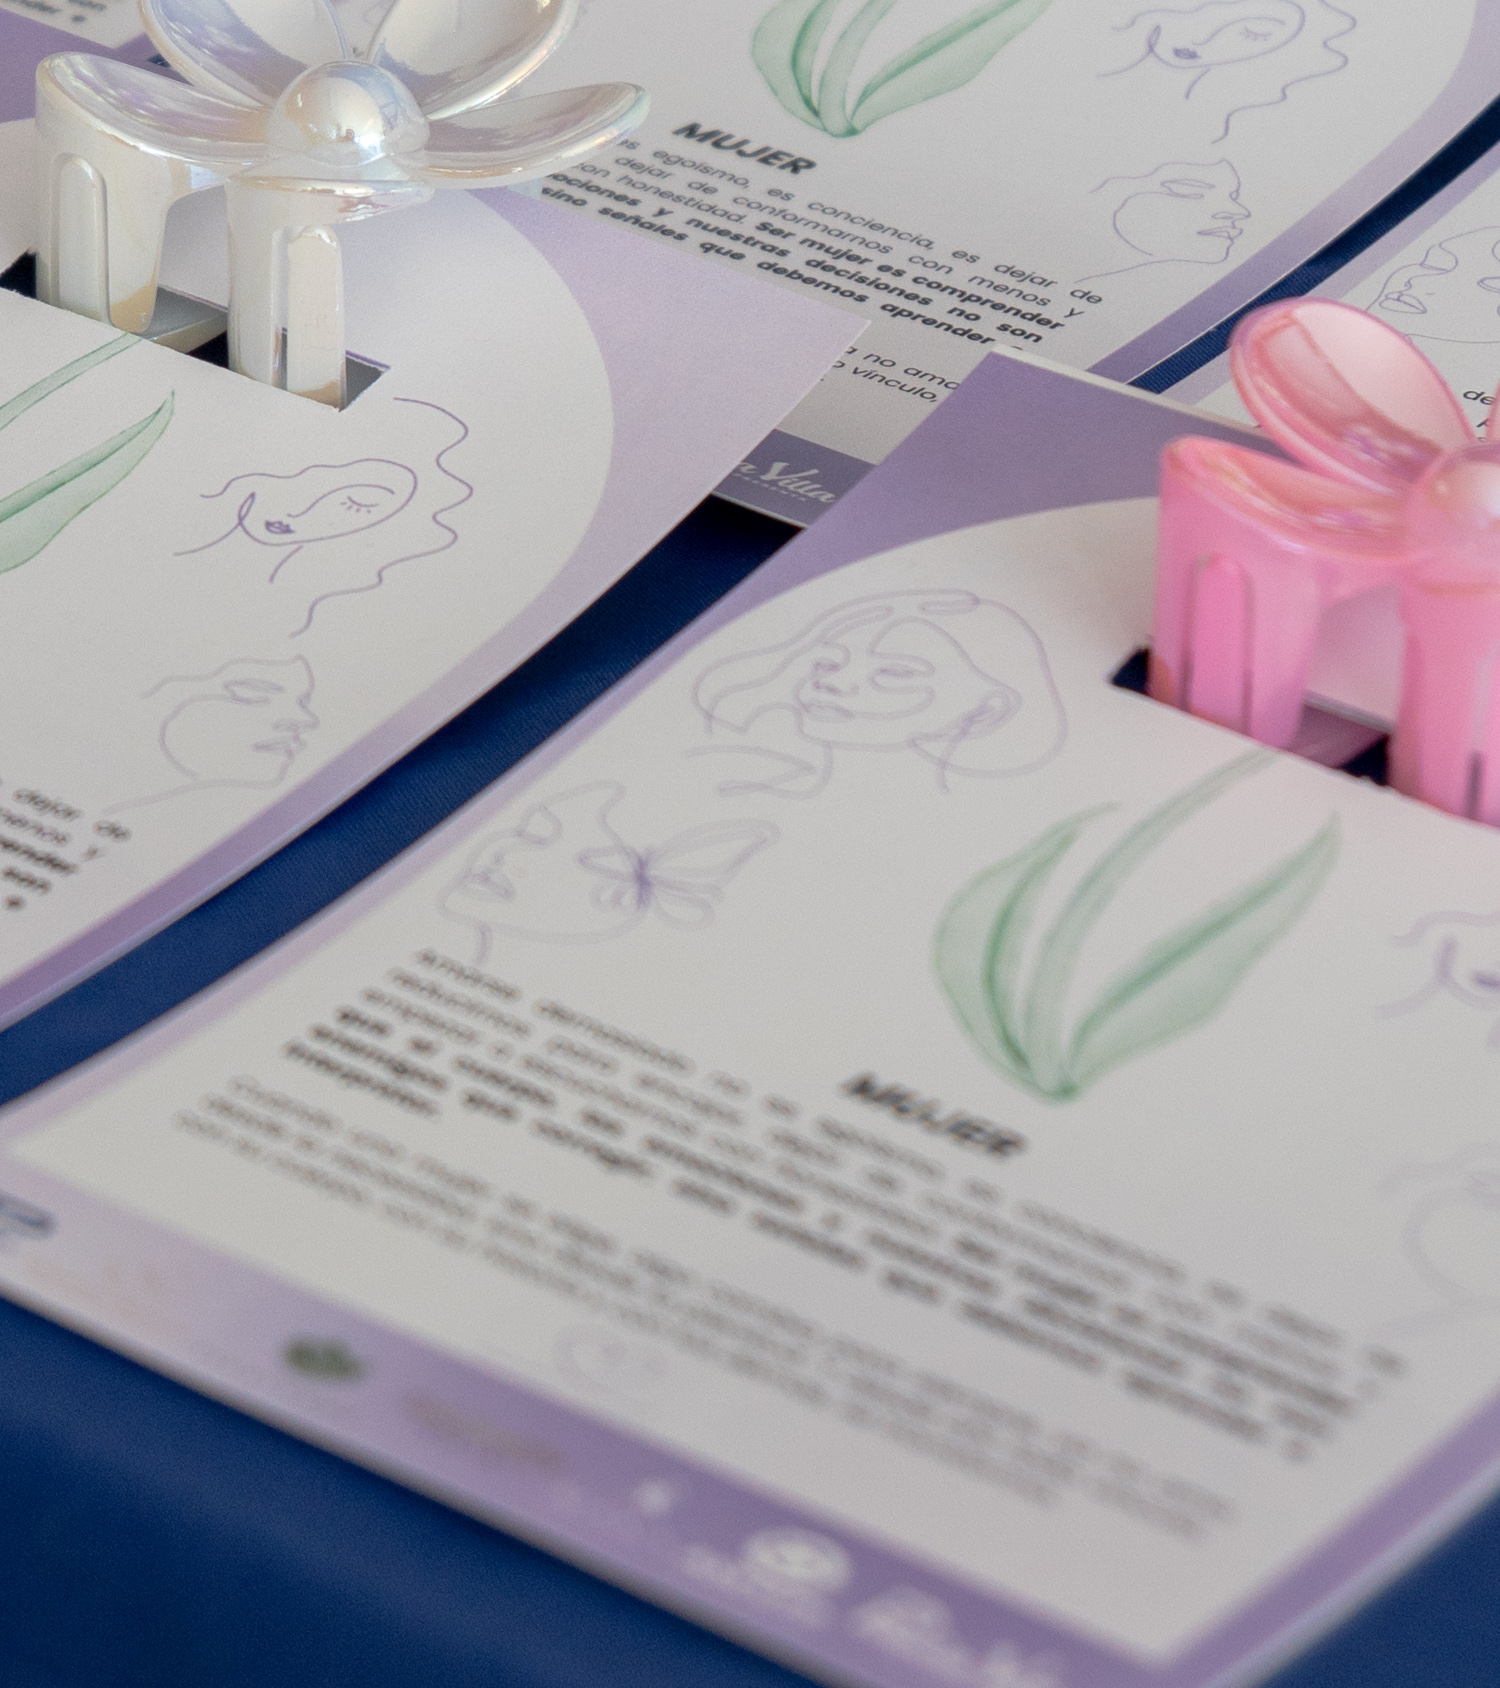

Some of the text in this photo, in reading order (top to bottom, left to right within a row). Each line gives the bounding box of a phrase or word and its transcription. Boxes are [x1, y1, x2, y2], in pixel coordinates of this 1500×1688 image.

[671, 122, 818, 175] MUJER
[541, 187, 995, 344] sino señales que debemos aprender
[545, 173, 1044, 344] ociones y nuestras decisiones no son
[572, 162, 1064, 330] on honestidad. Ser mujer es comprender
[614, 157, 1086, 319] dejar de conformarnos con menos y
[652, 150, 750, 190] egoísmo,
[764, 187, 796, 202] es
[806, 202, 935, 251] conciencia,
[950, 250, 981, 264] es
[993, 264, 1058, 288] dejar
[1069, 289, 1104, 305] de
[851, 365, 938, 403] vínculo,
[862, 353, 898, 368] no
[759, 461, 836, 504] Villa
